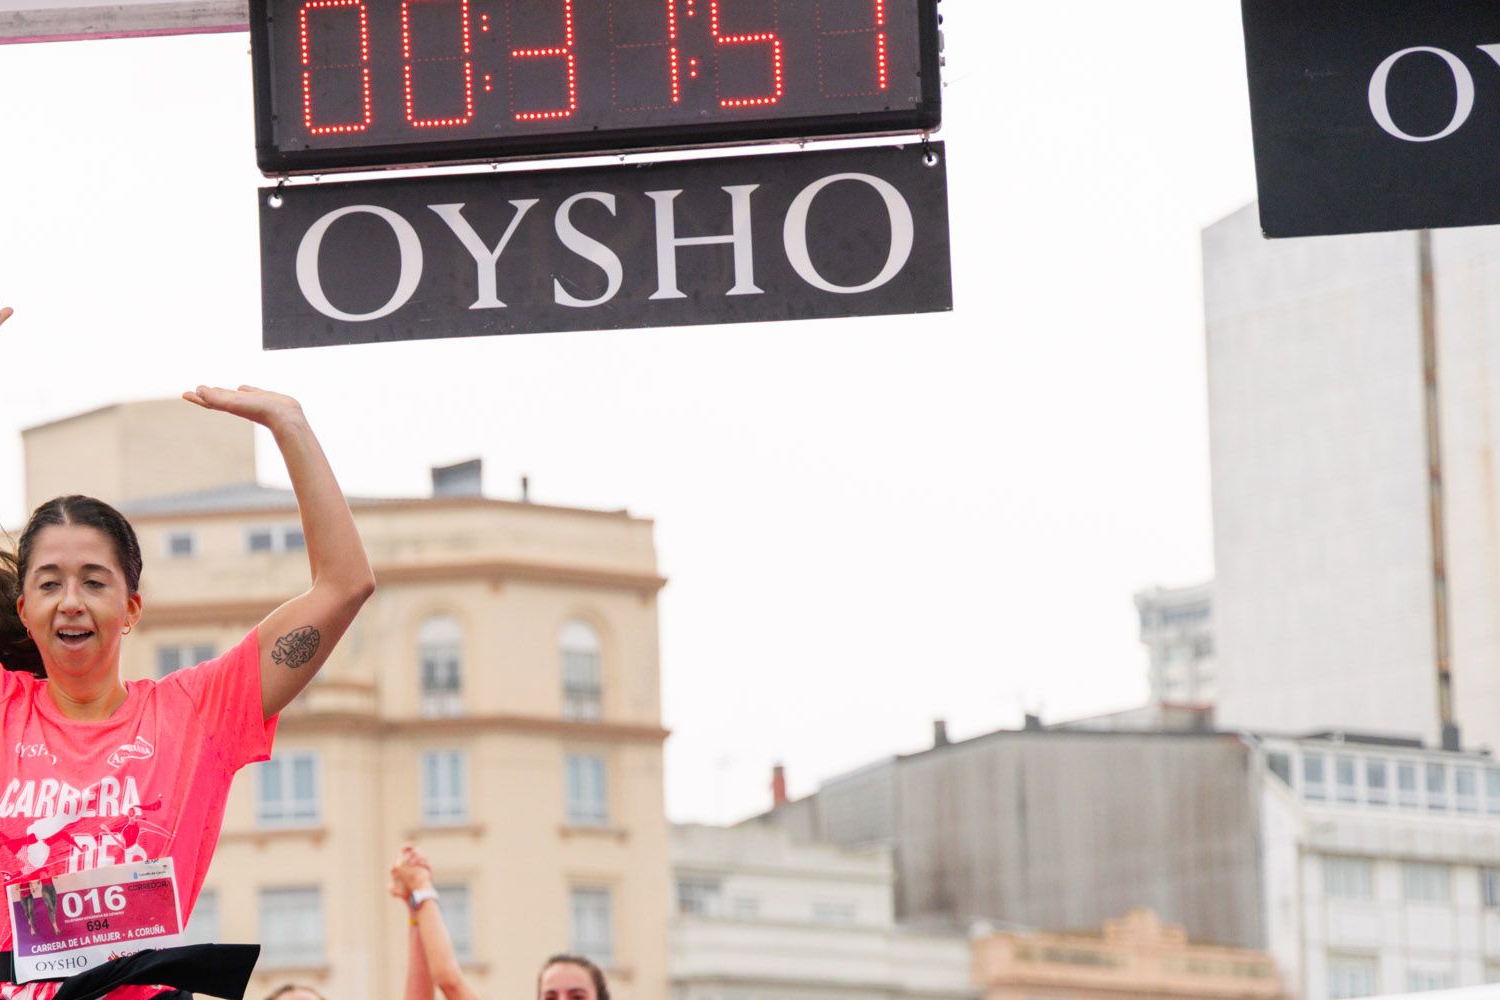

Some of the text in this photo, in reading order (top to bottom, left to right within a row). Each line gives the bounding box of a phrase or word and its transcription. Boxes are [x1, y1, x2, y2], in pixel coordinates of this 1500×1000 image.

[296, 172, 915, 323] OYSHO
[62, 886, 127, 918] 016
[31, 940, 67, 954] CARRERA
[68, 938, 79, 947] DE
[80, 936, 90, 945] LA
[92, 932, 121, 944] MUJER
[127, 929, 134, 938] A
[135, 924, 166, 938] CORUÑA
[86, 918, 110, 932] 694
[35, 955, 88, 972] OYSHO
